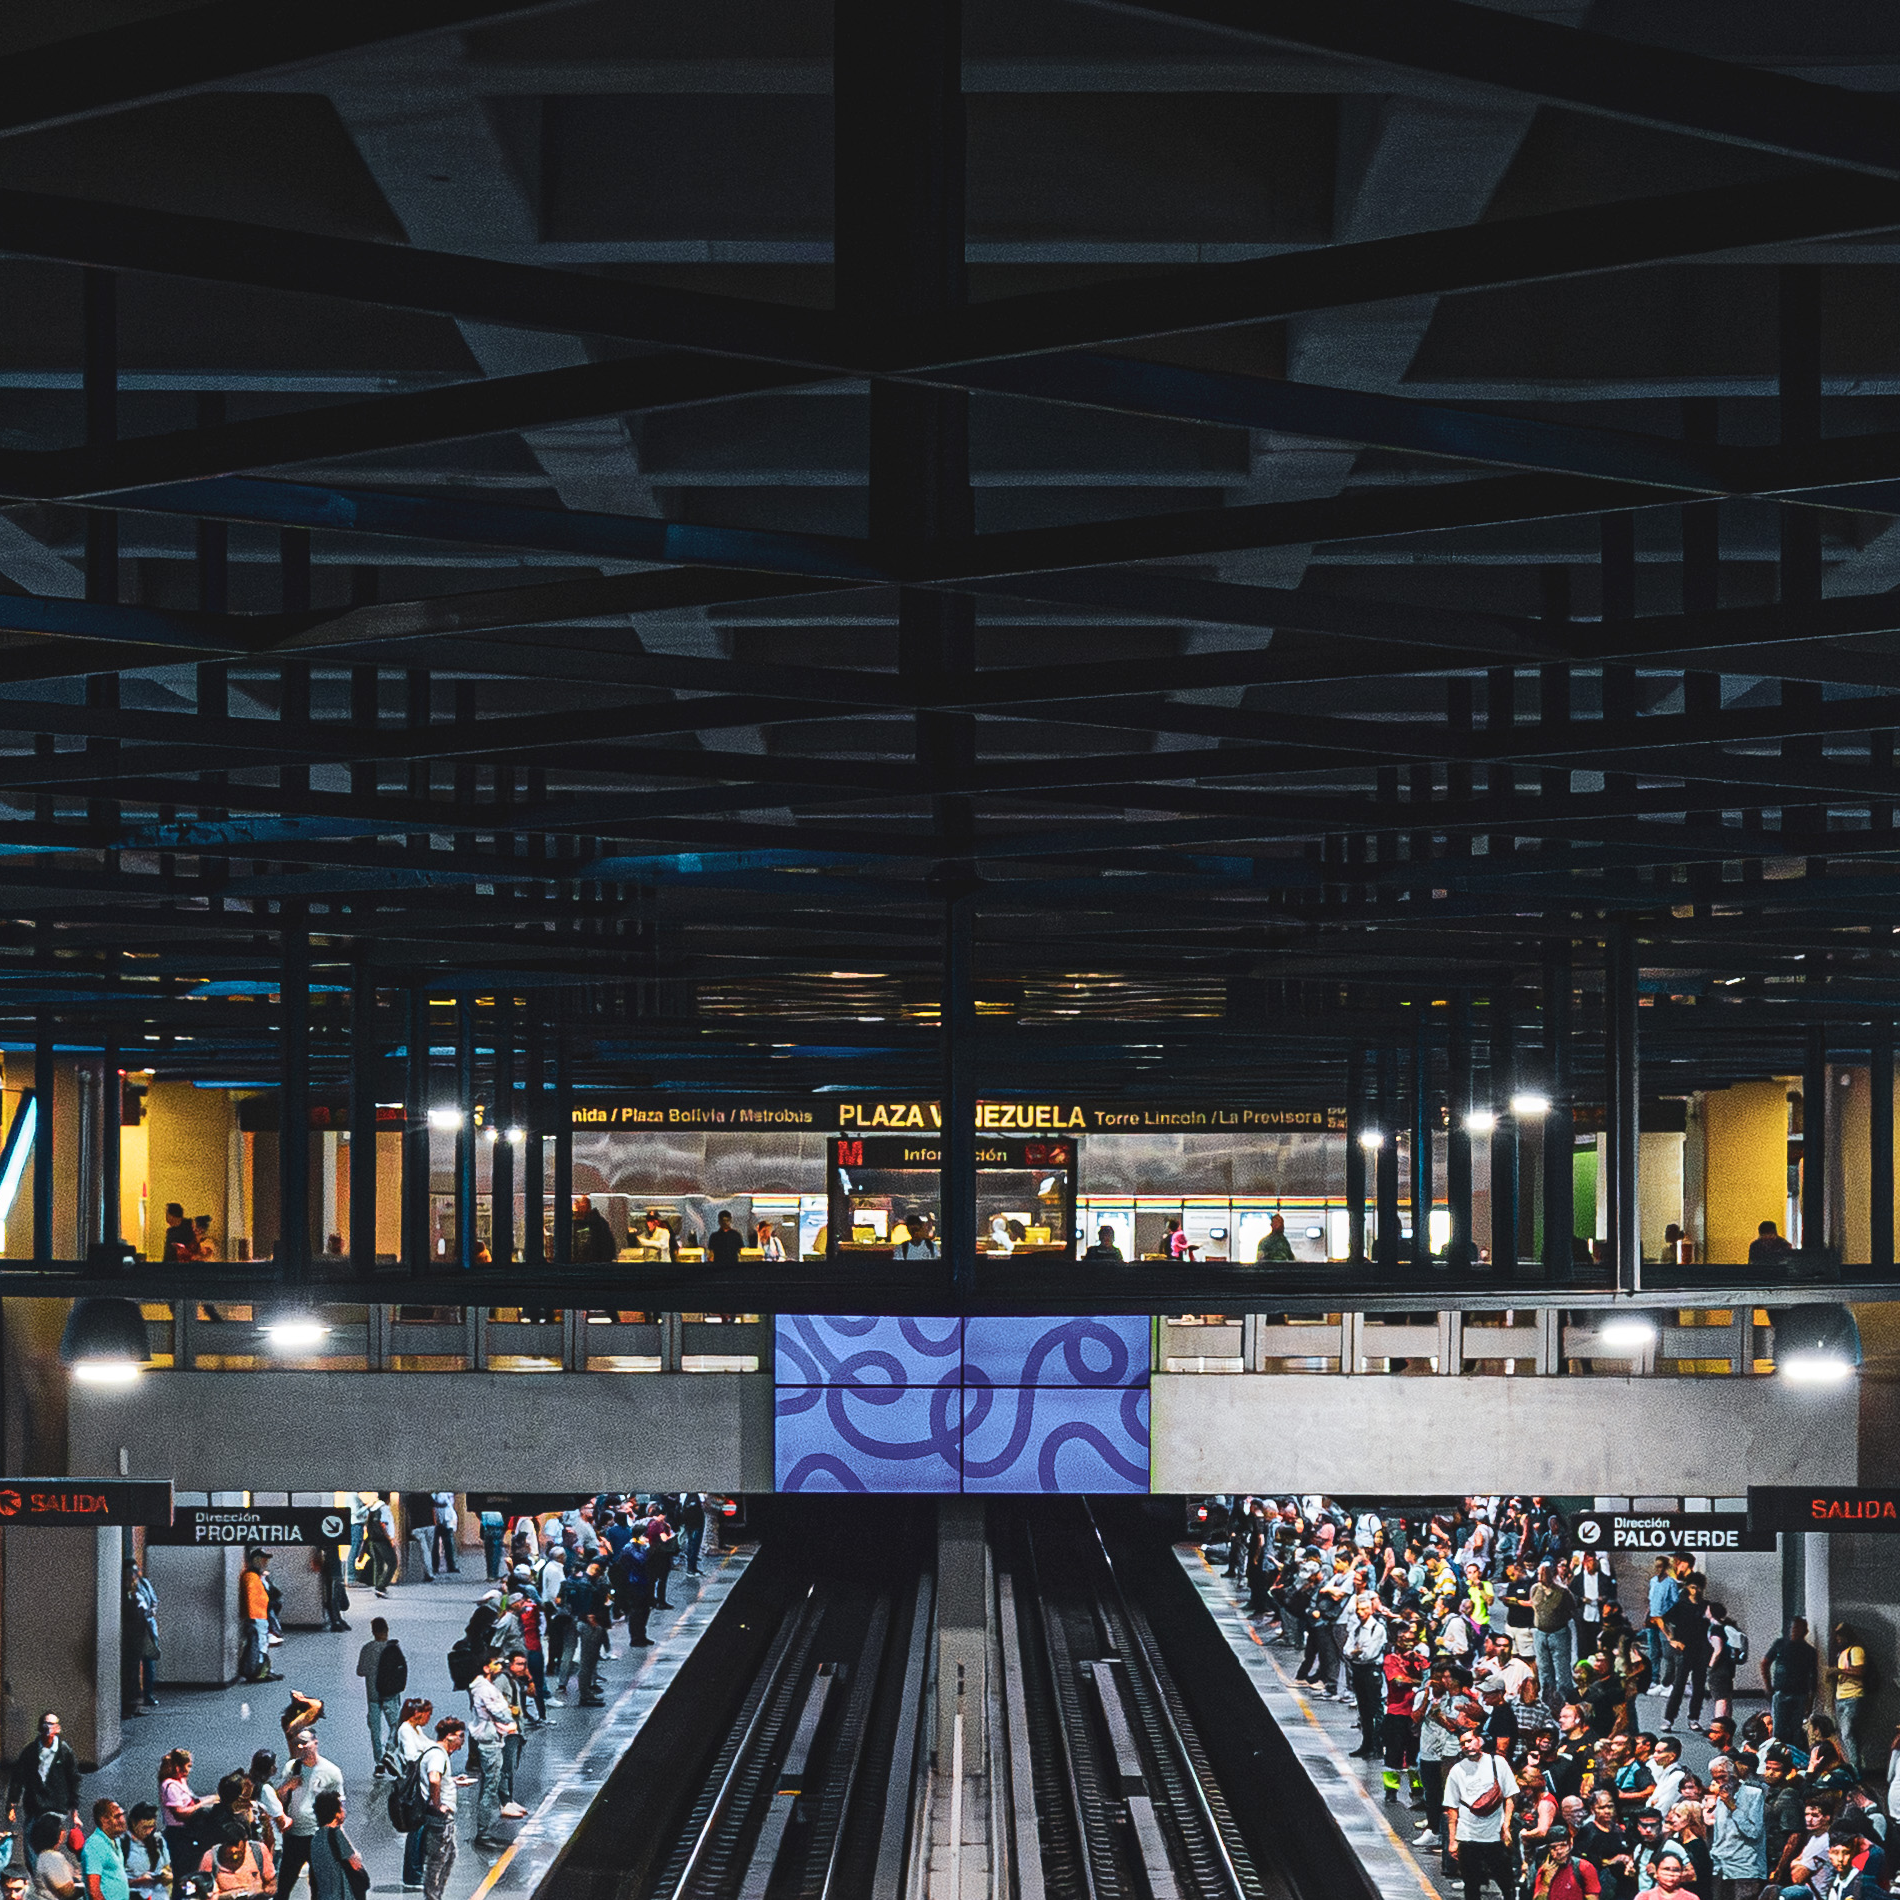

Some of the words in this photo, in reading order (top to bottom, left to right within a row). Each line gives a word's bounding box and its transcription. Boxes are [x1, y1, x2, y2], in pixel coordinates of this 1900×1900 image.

[621, 1107, 664, 1123] Plaza
[740, 1108, 813, 1123] Metrobus
[839, 1104, 924, 1127] PLAZA
[1094, 1111, 1140, 1125] Torre
[1243, 1110, 1322, 1125] Previsora
[30, 1493, 109, 1514] SALIDA
[1811, 1499, 1897, 1519] SALIDA
[195, 1512, 261, 1524] Dirección
[1614, 1517, 1670, 1529] Dirección
[195, 1525, 304, 1542] PROPATRIA
[1614, 1530, 1666, 1547] PALO
[1670, 1530, 1739, 1547] VERDE
